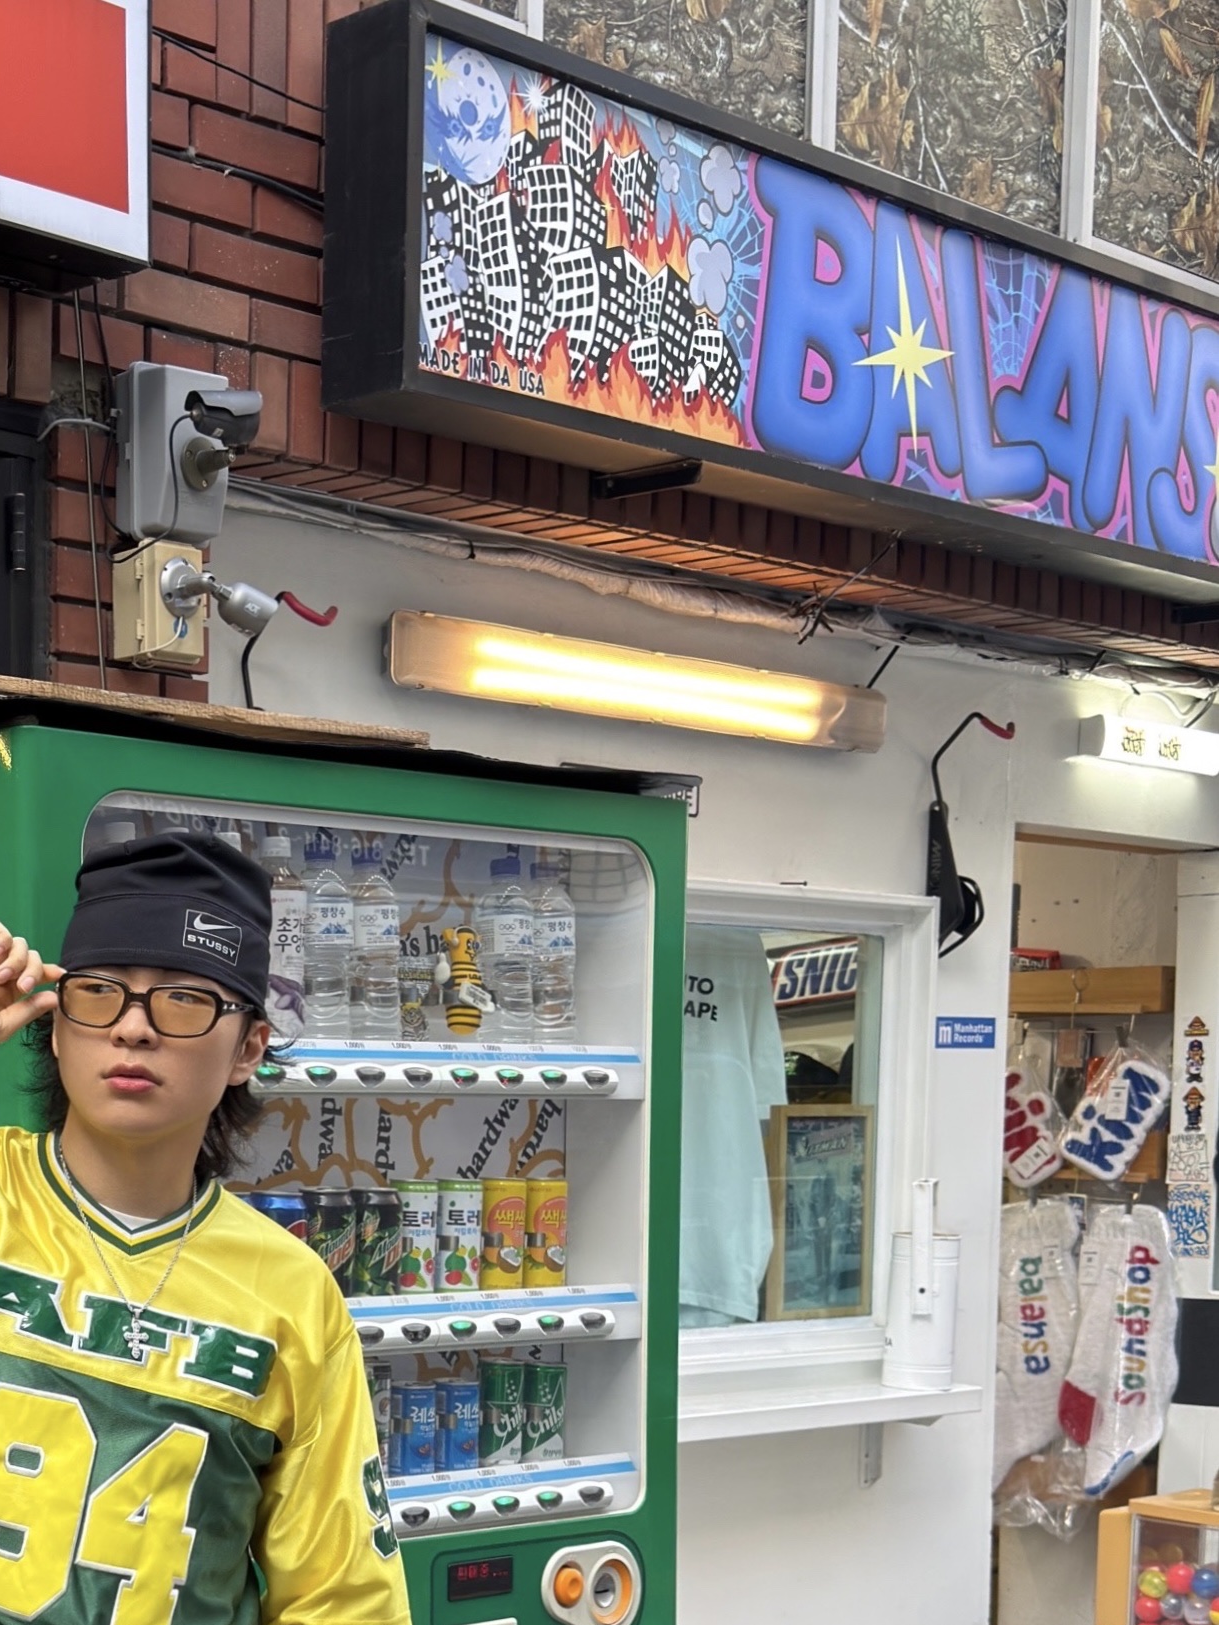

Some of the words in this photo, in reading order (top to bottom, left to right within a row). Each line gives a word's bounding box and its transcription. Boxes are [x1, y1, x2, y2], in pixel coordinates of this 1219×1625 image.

[418, 342, 460, 376] MADE
[467, 356, 486, 382] IN
[490, 361, 513, 390] DA
[518, 367, 547, 398] USA
[187, 934, 237, 958] STUSSY
[954, 1024, 993, 1034] Manhattan
[954, 1033, 983, 1043] Records
[1018, 1255, 1051, 1376] balansa
